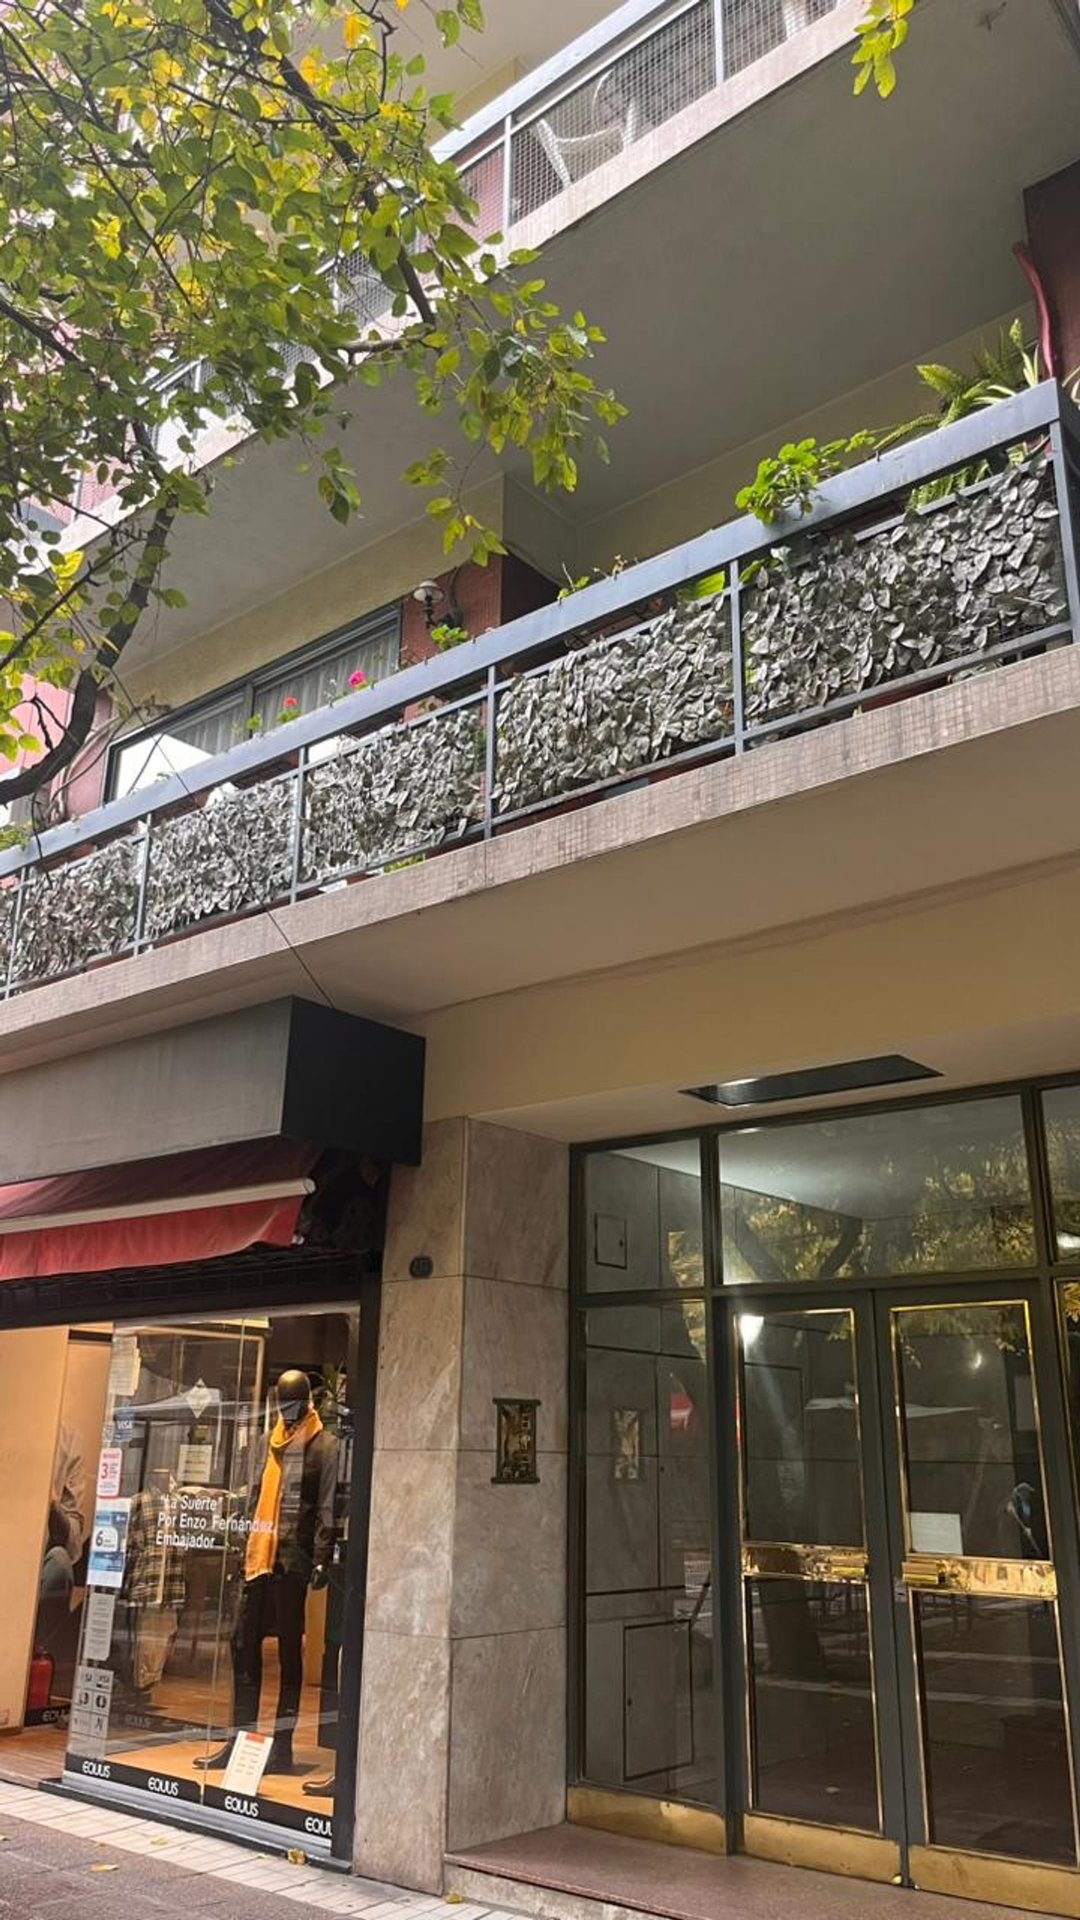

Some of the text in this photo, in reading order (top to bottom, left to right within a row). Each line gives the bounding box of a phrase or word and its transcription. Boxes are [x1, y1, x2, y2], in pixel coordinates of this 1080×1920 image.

[101, 1462, 109, 1479] 3
[157, 1512, 178, 1528] Por
[179, 1513, 207, 1530] Enzo
[96, 1530, 104, 1547] 6
[155, 1530, 216, 1551] Embajador
[82, 1760, 111, 1779] EQUUS
[147, 1776, 180, 1797] EQUUS
[224, 1795, 260, 1818] EQUUS
